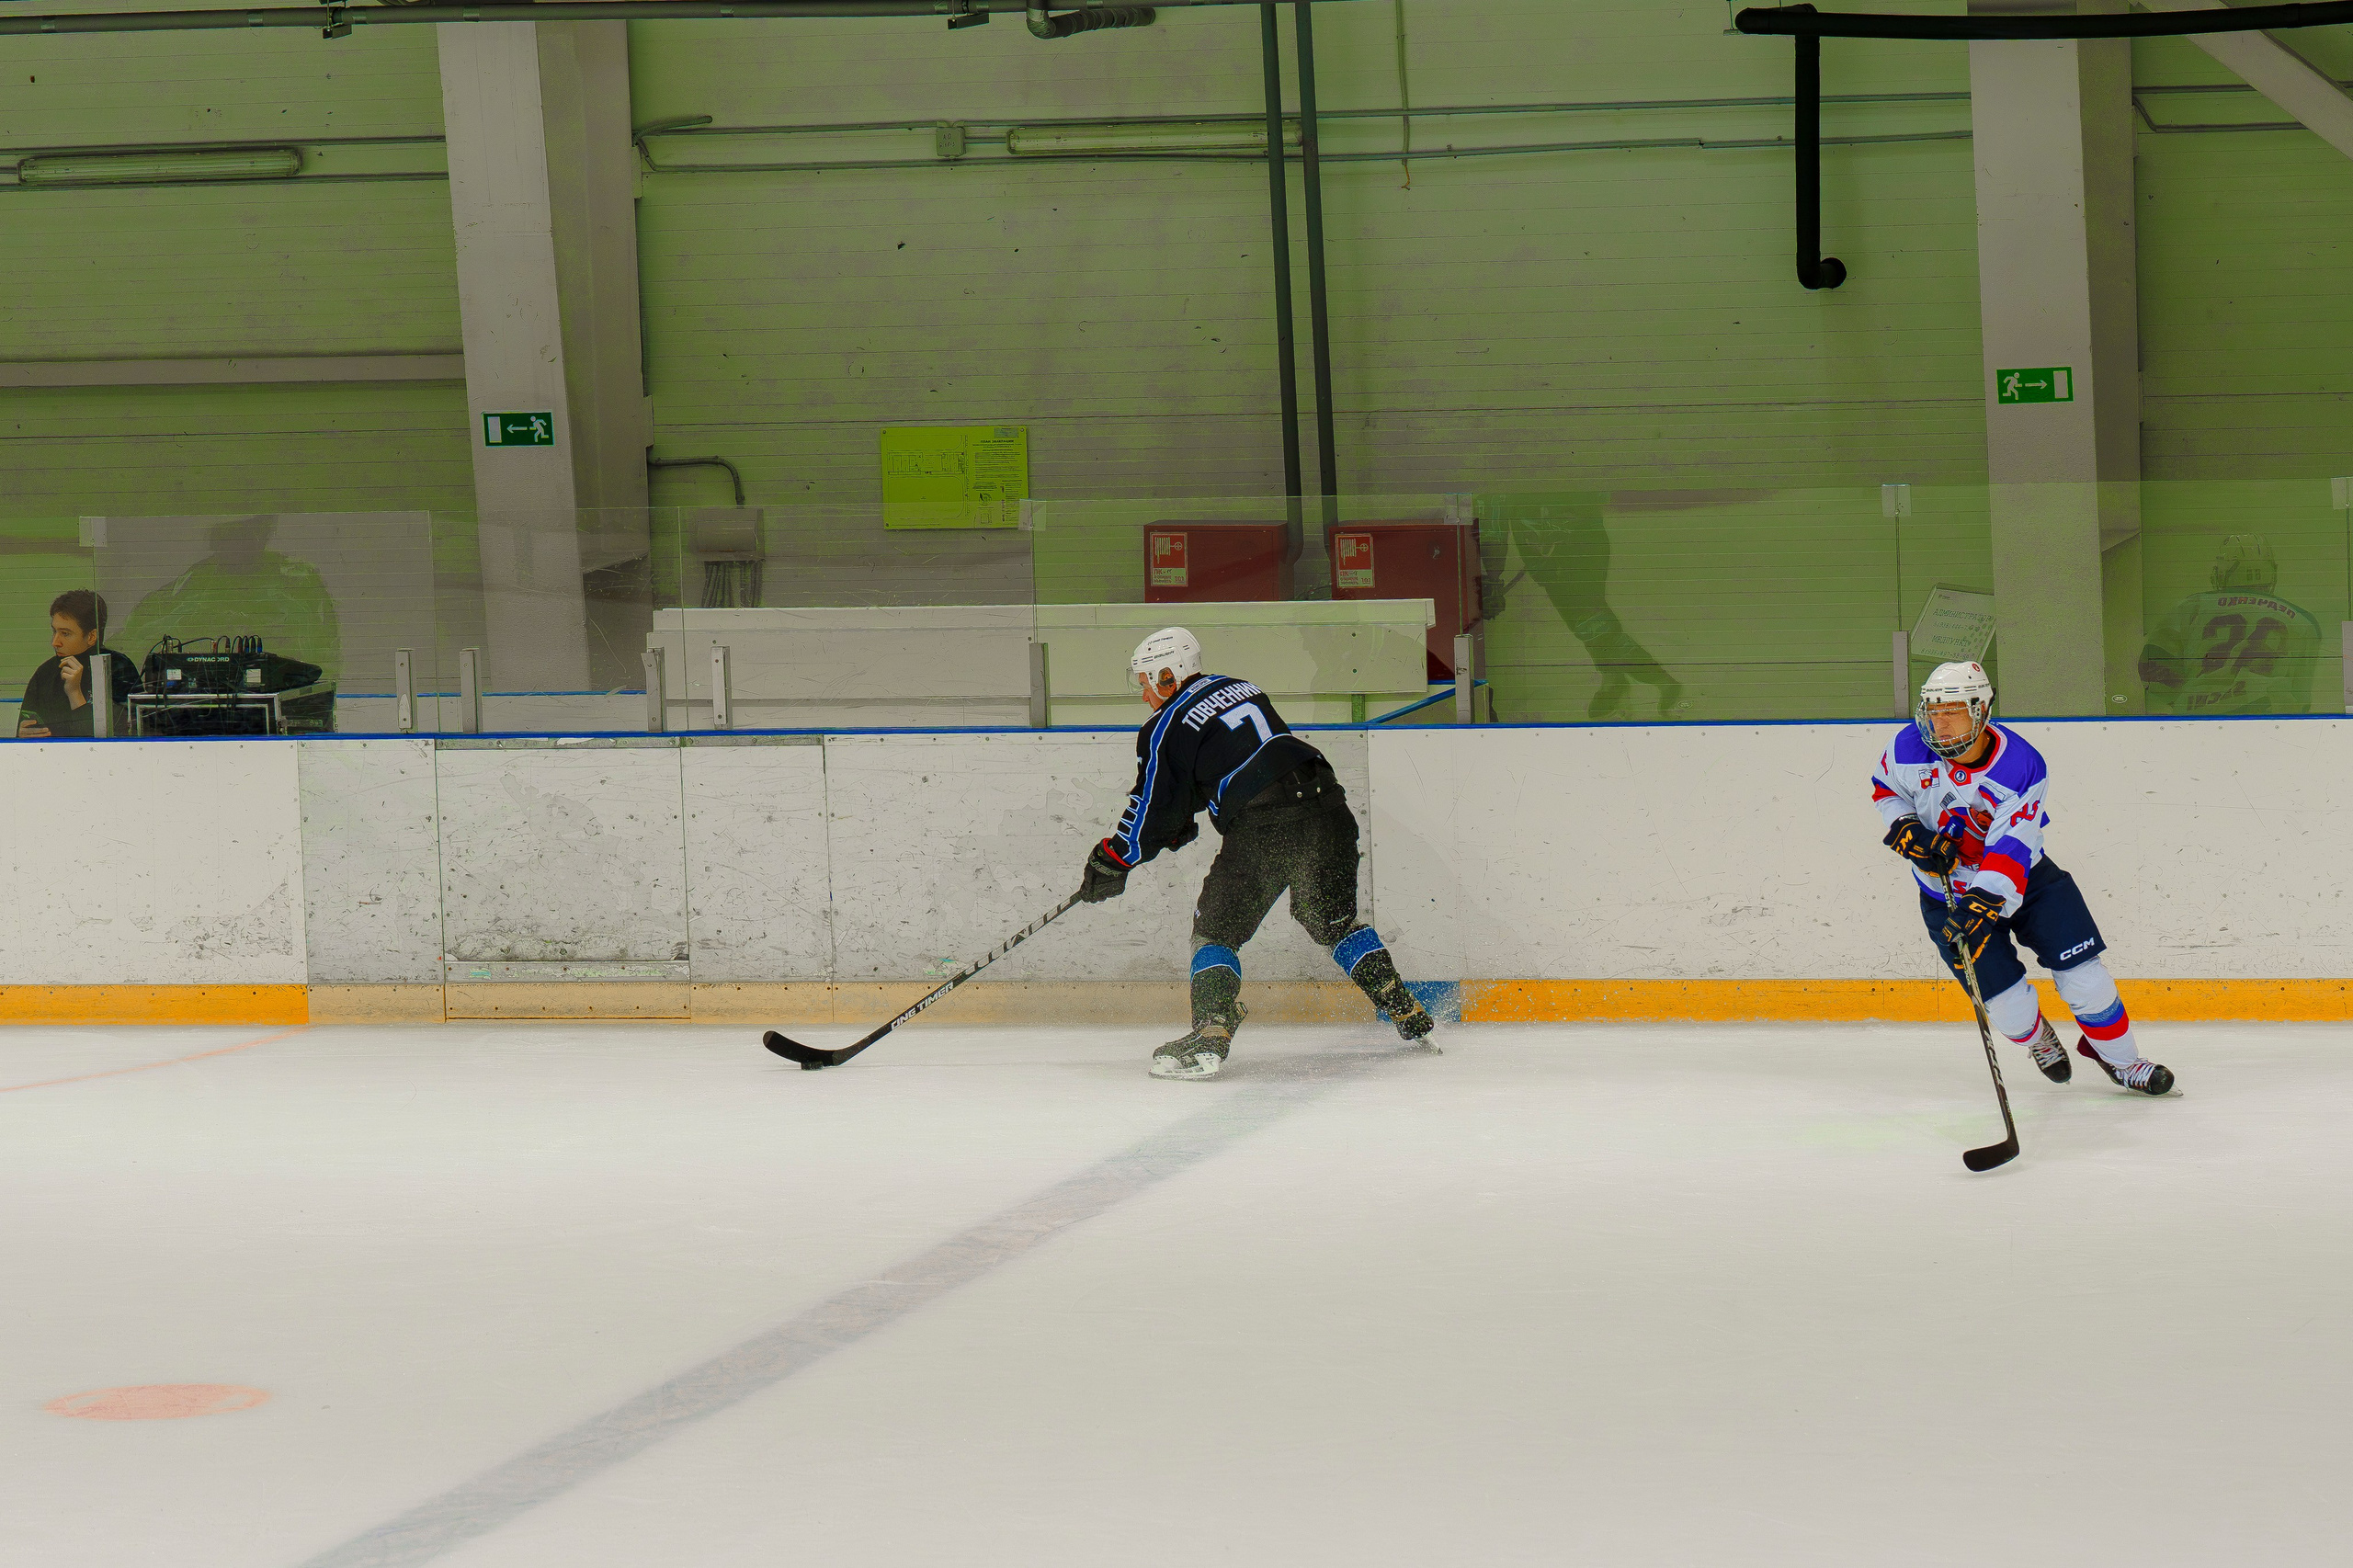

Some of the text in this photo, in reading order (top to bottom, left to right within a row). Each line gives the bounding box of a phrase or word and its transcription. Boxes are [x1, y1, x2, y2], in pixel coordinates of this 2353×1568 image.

[1219, 701, 1273, 743] 7
[2059, 937, 2095, 961] CCM
[891, 981, 954, 1029] ONE TIMER
